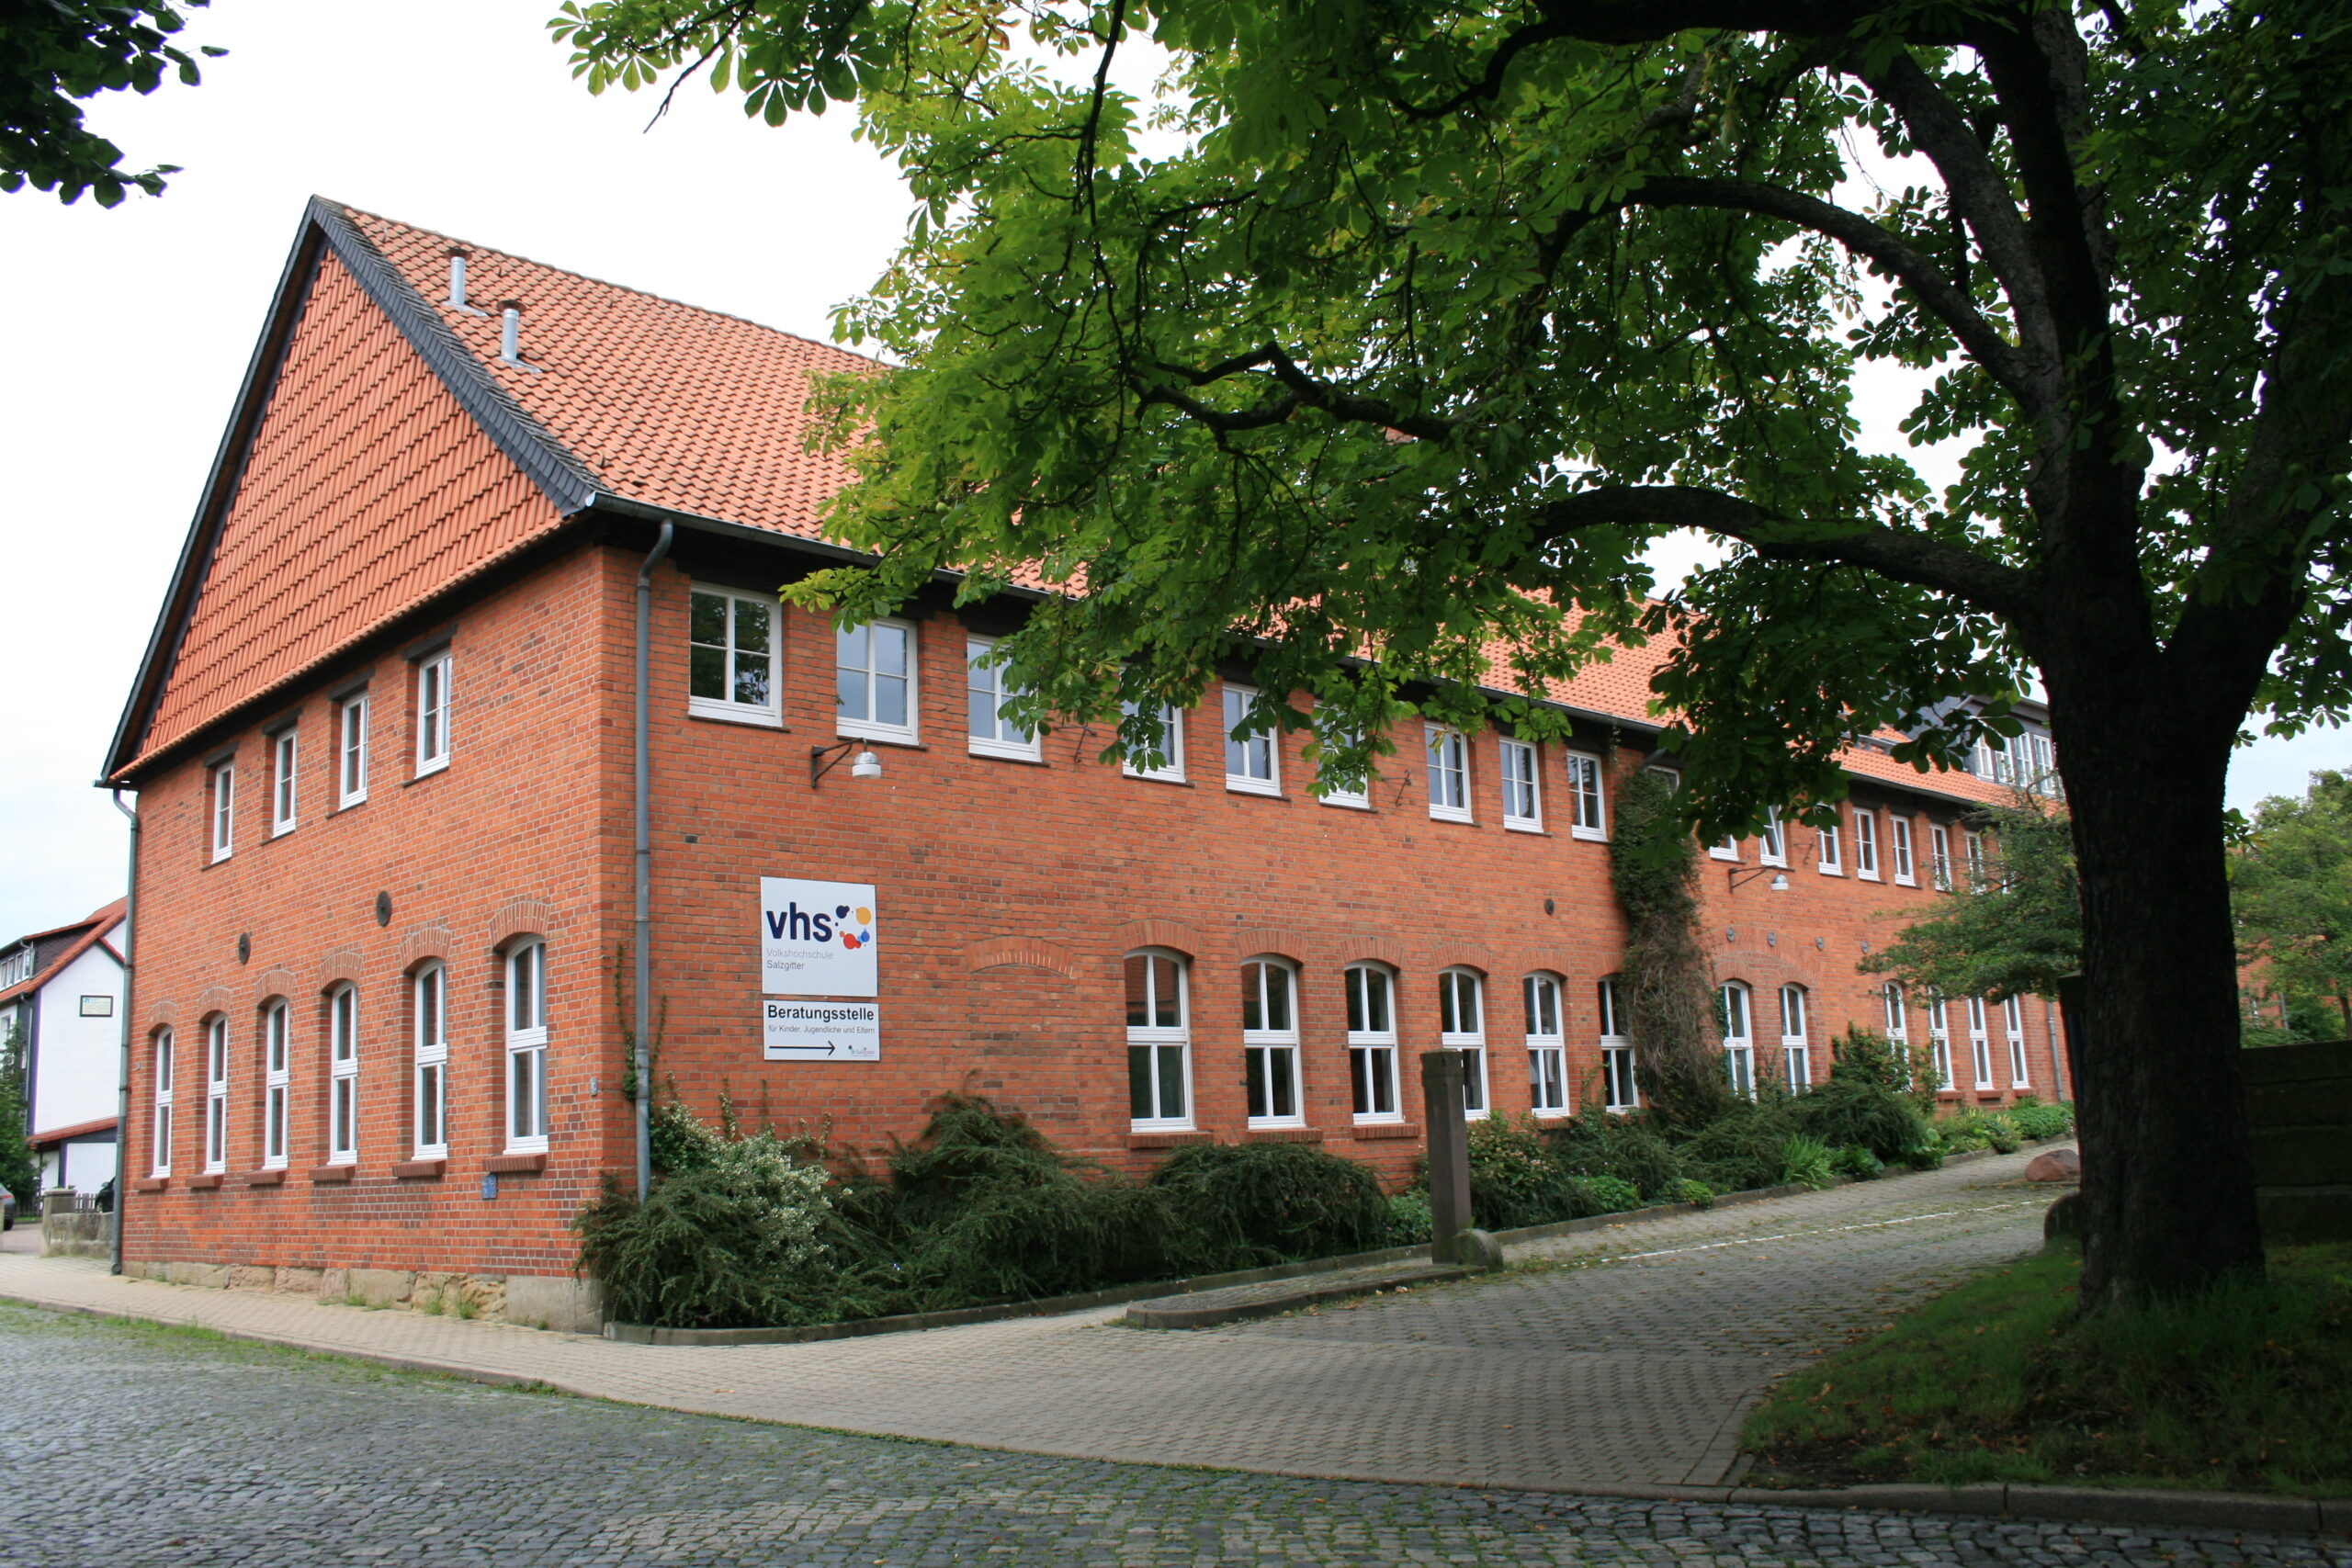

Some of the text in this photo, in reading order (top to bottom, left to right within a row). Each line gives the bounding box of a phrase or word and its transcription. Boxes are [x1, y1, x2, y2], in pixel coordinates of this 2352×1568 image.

[766, 902, 832, 942] vhs
[766, 948, 833, 959] Volkshochschule
[766, 960, 805, 971] Salzgitter
[768, 1005, 874, 1022] Beratungsstelle
[779, 1025, 802, 1033] Kinder,
[804, 1025, 842, 1034] Jugendliche
